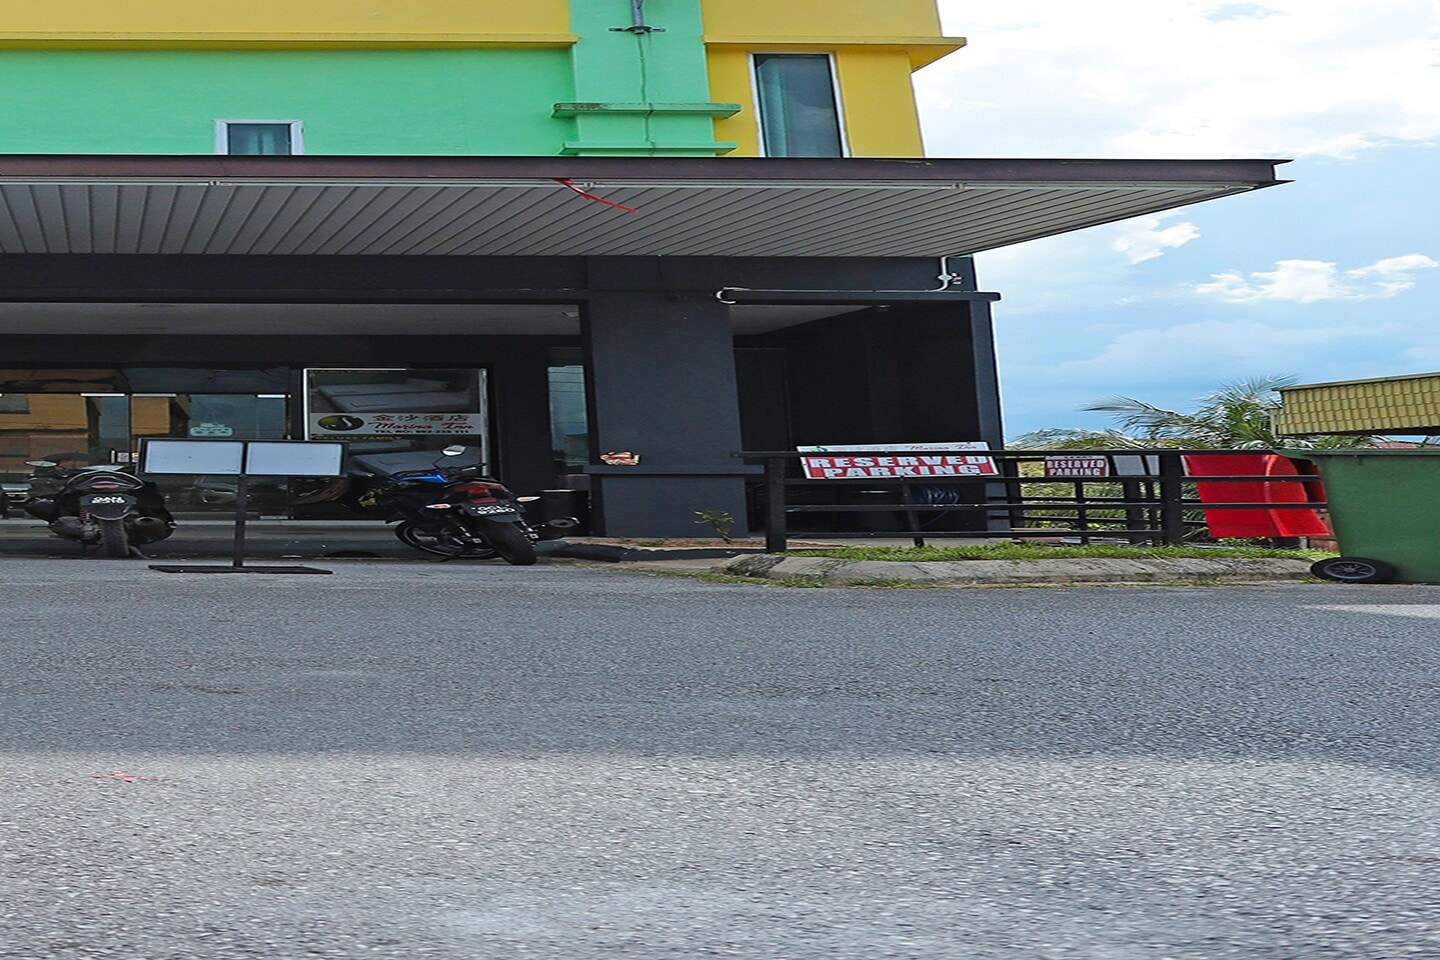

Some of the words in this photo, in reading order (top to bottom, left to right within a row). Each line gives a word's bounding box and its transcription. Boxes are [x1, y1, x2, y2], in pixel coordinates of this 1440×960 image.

[367, 421, 432, 430] Marina
[442, 422, 474, 430] Inn
[809, 455, 988, 468] RESERVED
[1046, 460, 1105, 468] RESERVED
[823, 465, 981, 478] PARKING
[1049, 468, 1101, 476] PARKING
